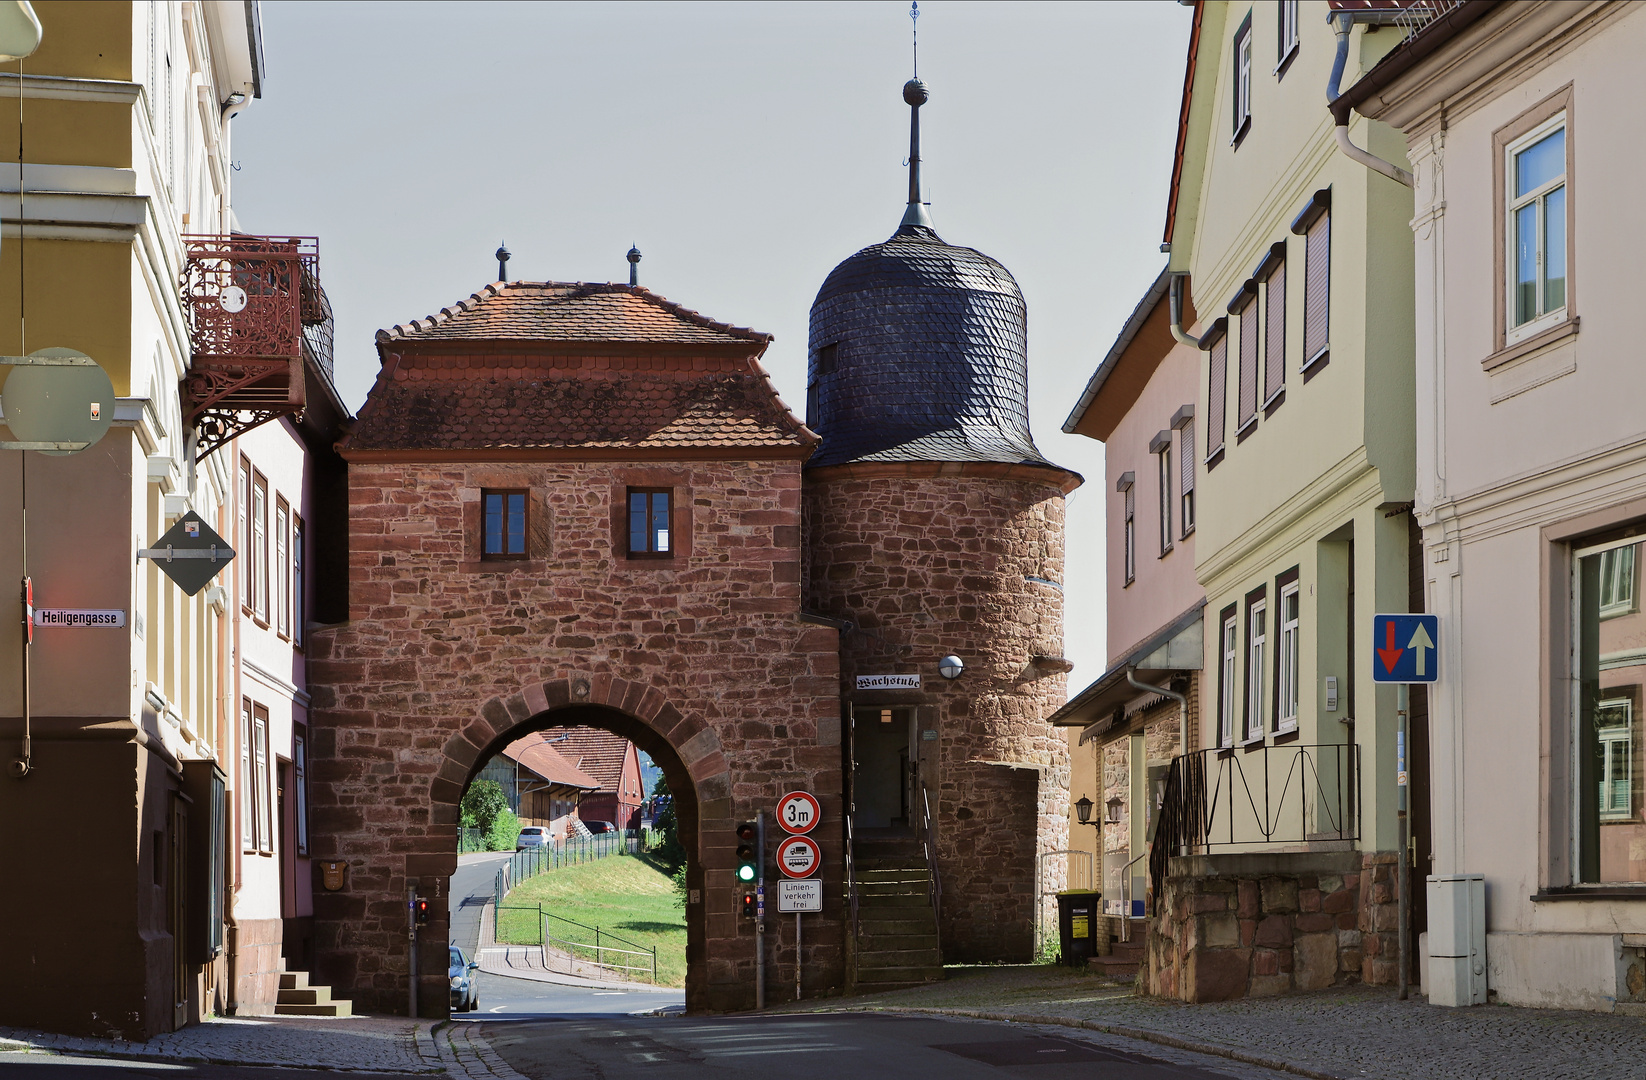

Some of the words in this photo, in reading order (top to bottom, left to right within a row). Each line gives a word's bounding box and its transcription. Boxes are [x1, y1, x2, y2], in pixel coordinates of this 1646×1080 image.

[42, 611, 117, 626] Heiligengasse
[857, 675, 920, 688] Wachstube
[788, 804, 797, 822] 3
[798, 810, 809, 822] m
[785, 883, 814, 891] Linien-
[784, 892, 816, 900] verkehr
